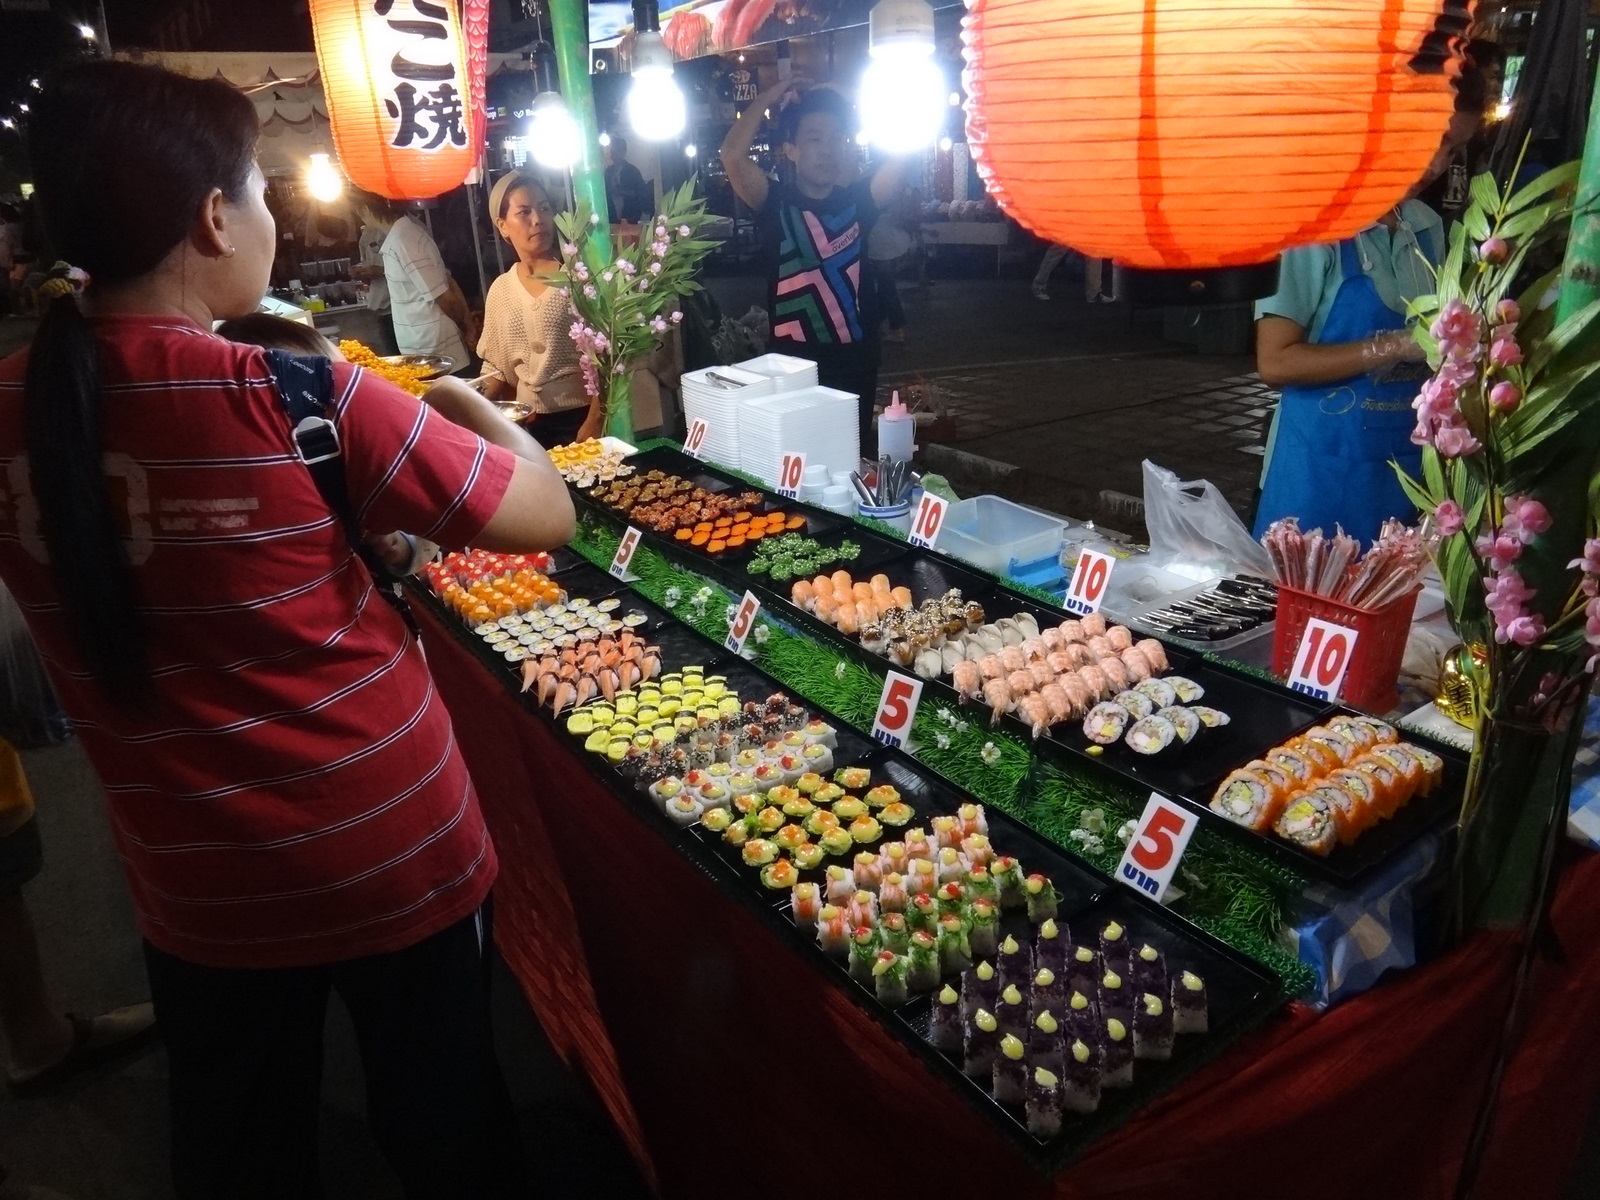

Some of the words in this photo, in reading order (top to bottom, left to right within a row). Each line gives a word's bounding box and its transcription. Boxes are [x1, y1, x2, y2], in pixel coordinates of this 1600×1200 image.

[687, 421, 705, 451] 10
[781, 455, 803, 489] 10
[915, 497, 942, 539] 10
[616, 531, 638, 565] 5
[611, 564, 623, 576] บาท
[1073, 553, 1107, 602] 10
[732, 598, 756, 639] 5
[727, 635, 739, 653] บาท
[1300, 627, 1347, 686] 10
[878, 678, 914, 730] 5
[1130, 805, 1186, 870] 5
[1123, 862, 1161, 896] บาท
